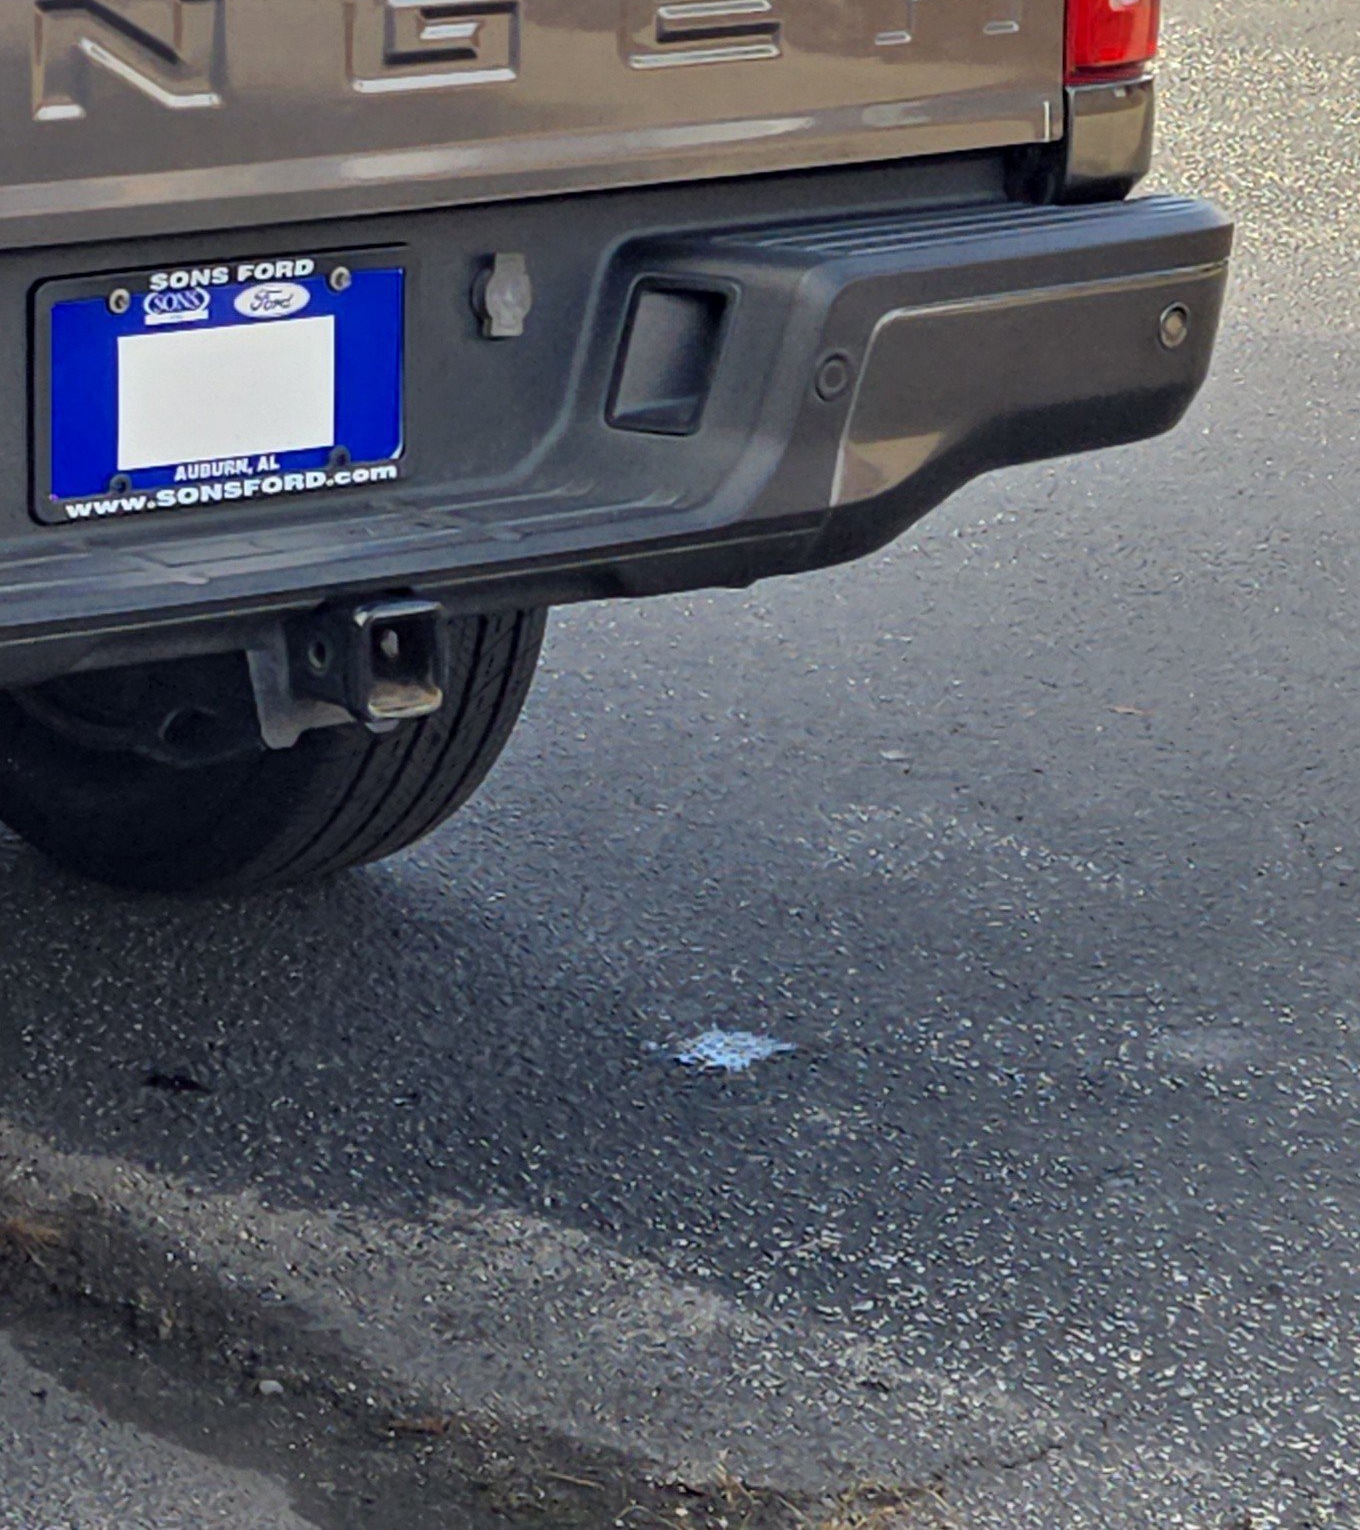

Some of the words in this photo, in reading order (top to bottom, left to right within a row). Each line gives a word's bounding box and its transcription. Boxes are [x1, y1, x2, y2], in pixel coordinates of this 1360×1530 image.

[149, 267, 230, 292] SONS
[236, 258, 315, 282] FORD
[249, 288, 295, 312] Ford
[174, 458, 253, 482] AUBURN,
[256, 454, 280, 471] AL
[65, 465, 397, 519] www.SONSFORD.com
